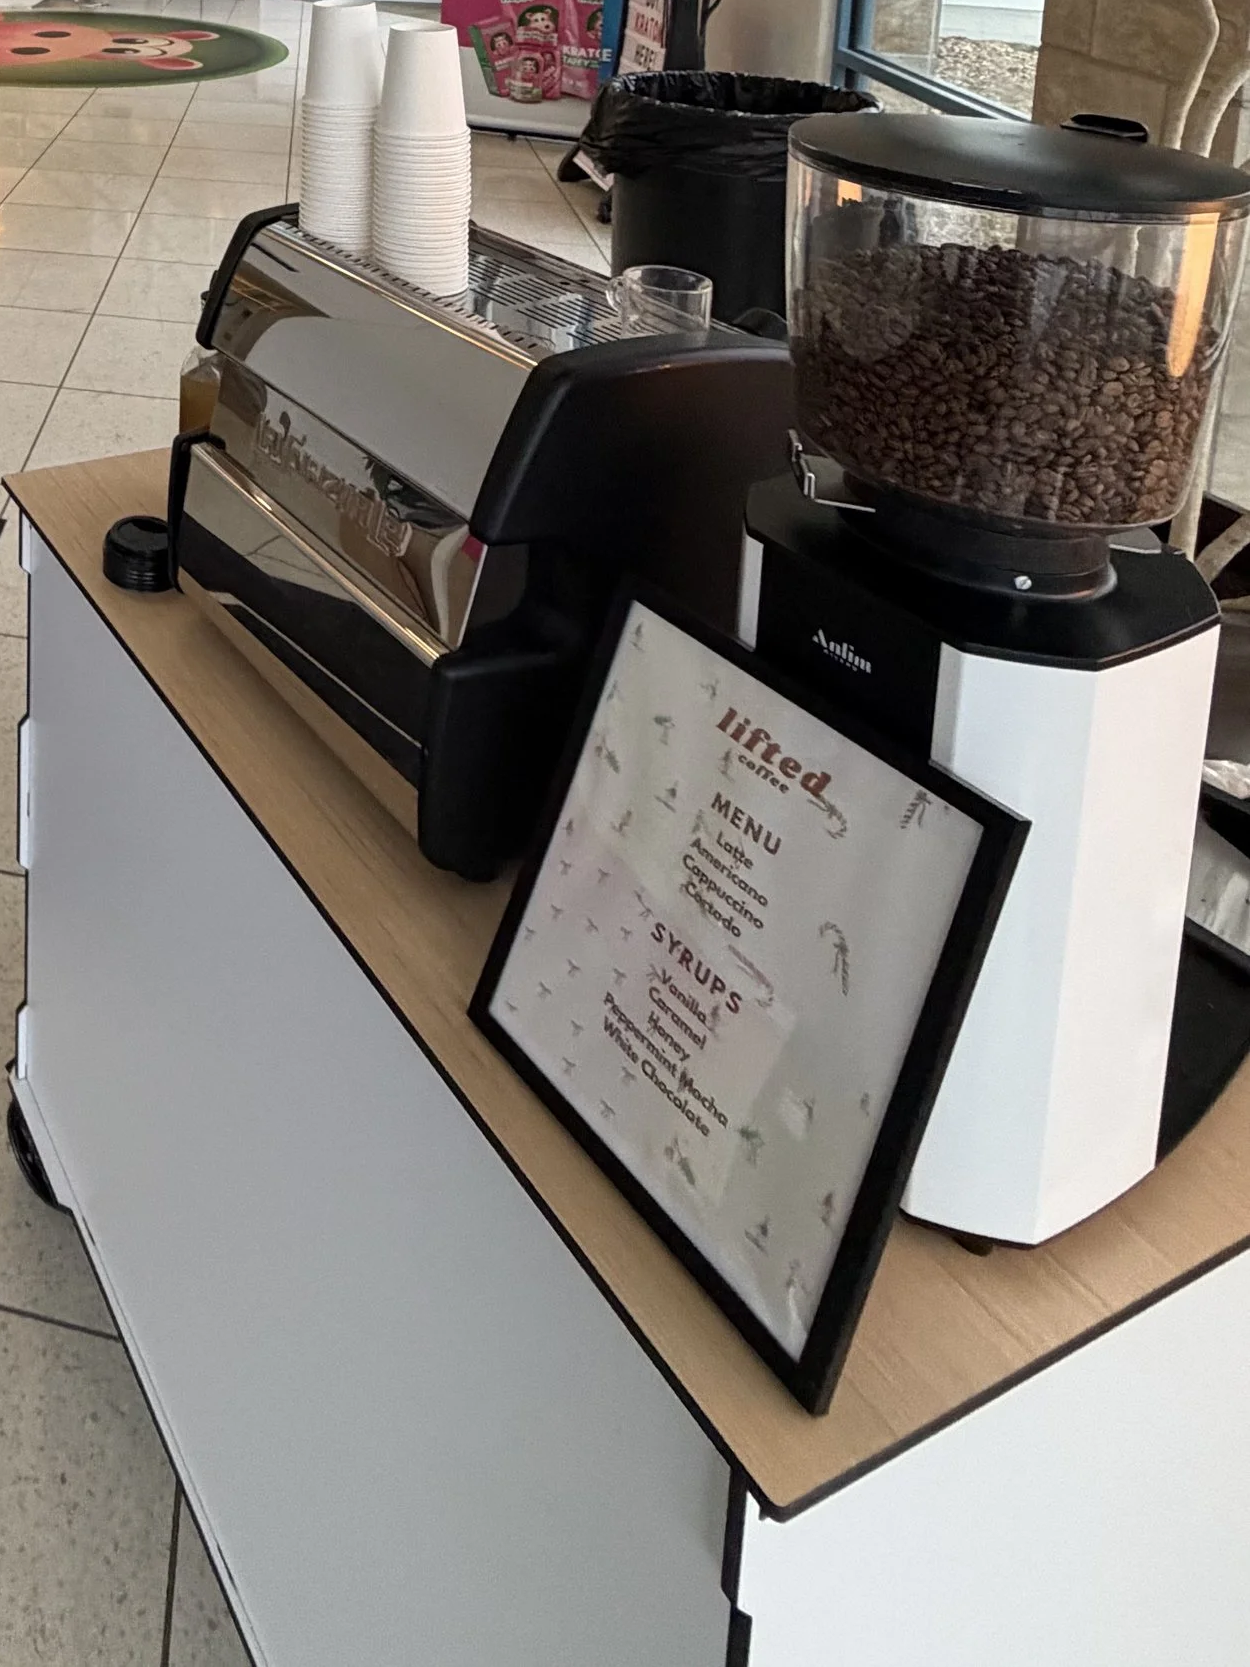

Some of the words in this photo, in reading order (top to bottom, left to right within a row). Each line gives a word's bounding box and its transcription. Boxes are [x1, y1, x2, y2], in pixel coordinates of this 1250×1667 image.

[716, 707, 832, 797] lifted
[737, 753, 791, 795] coffee
[710, 791, 782, 856] MENU
[716, 831, 754, 871] Latte
[682, 854, 764, 930] Cappuccino
[690, 837, 768, 908] Americano
[650, 922, 743, 1015] SYRUPS
[660, 968, 709, 1026] Vanilla
[647, 1010, 691, 1062] Honey
[649, 986, 707, 1051] Caramel
[603, 991, 678, 1079] Peppermint
[678, 1068, 730, 1129] Mocha
[603, 1015, 639, 1065] White
[641, 1059, 711, 1138] Chocolate
